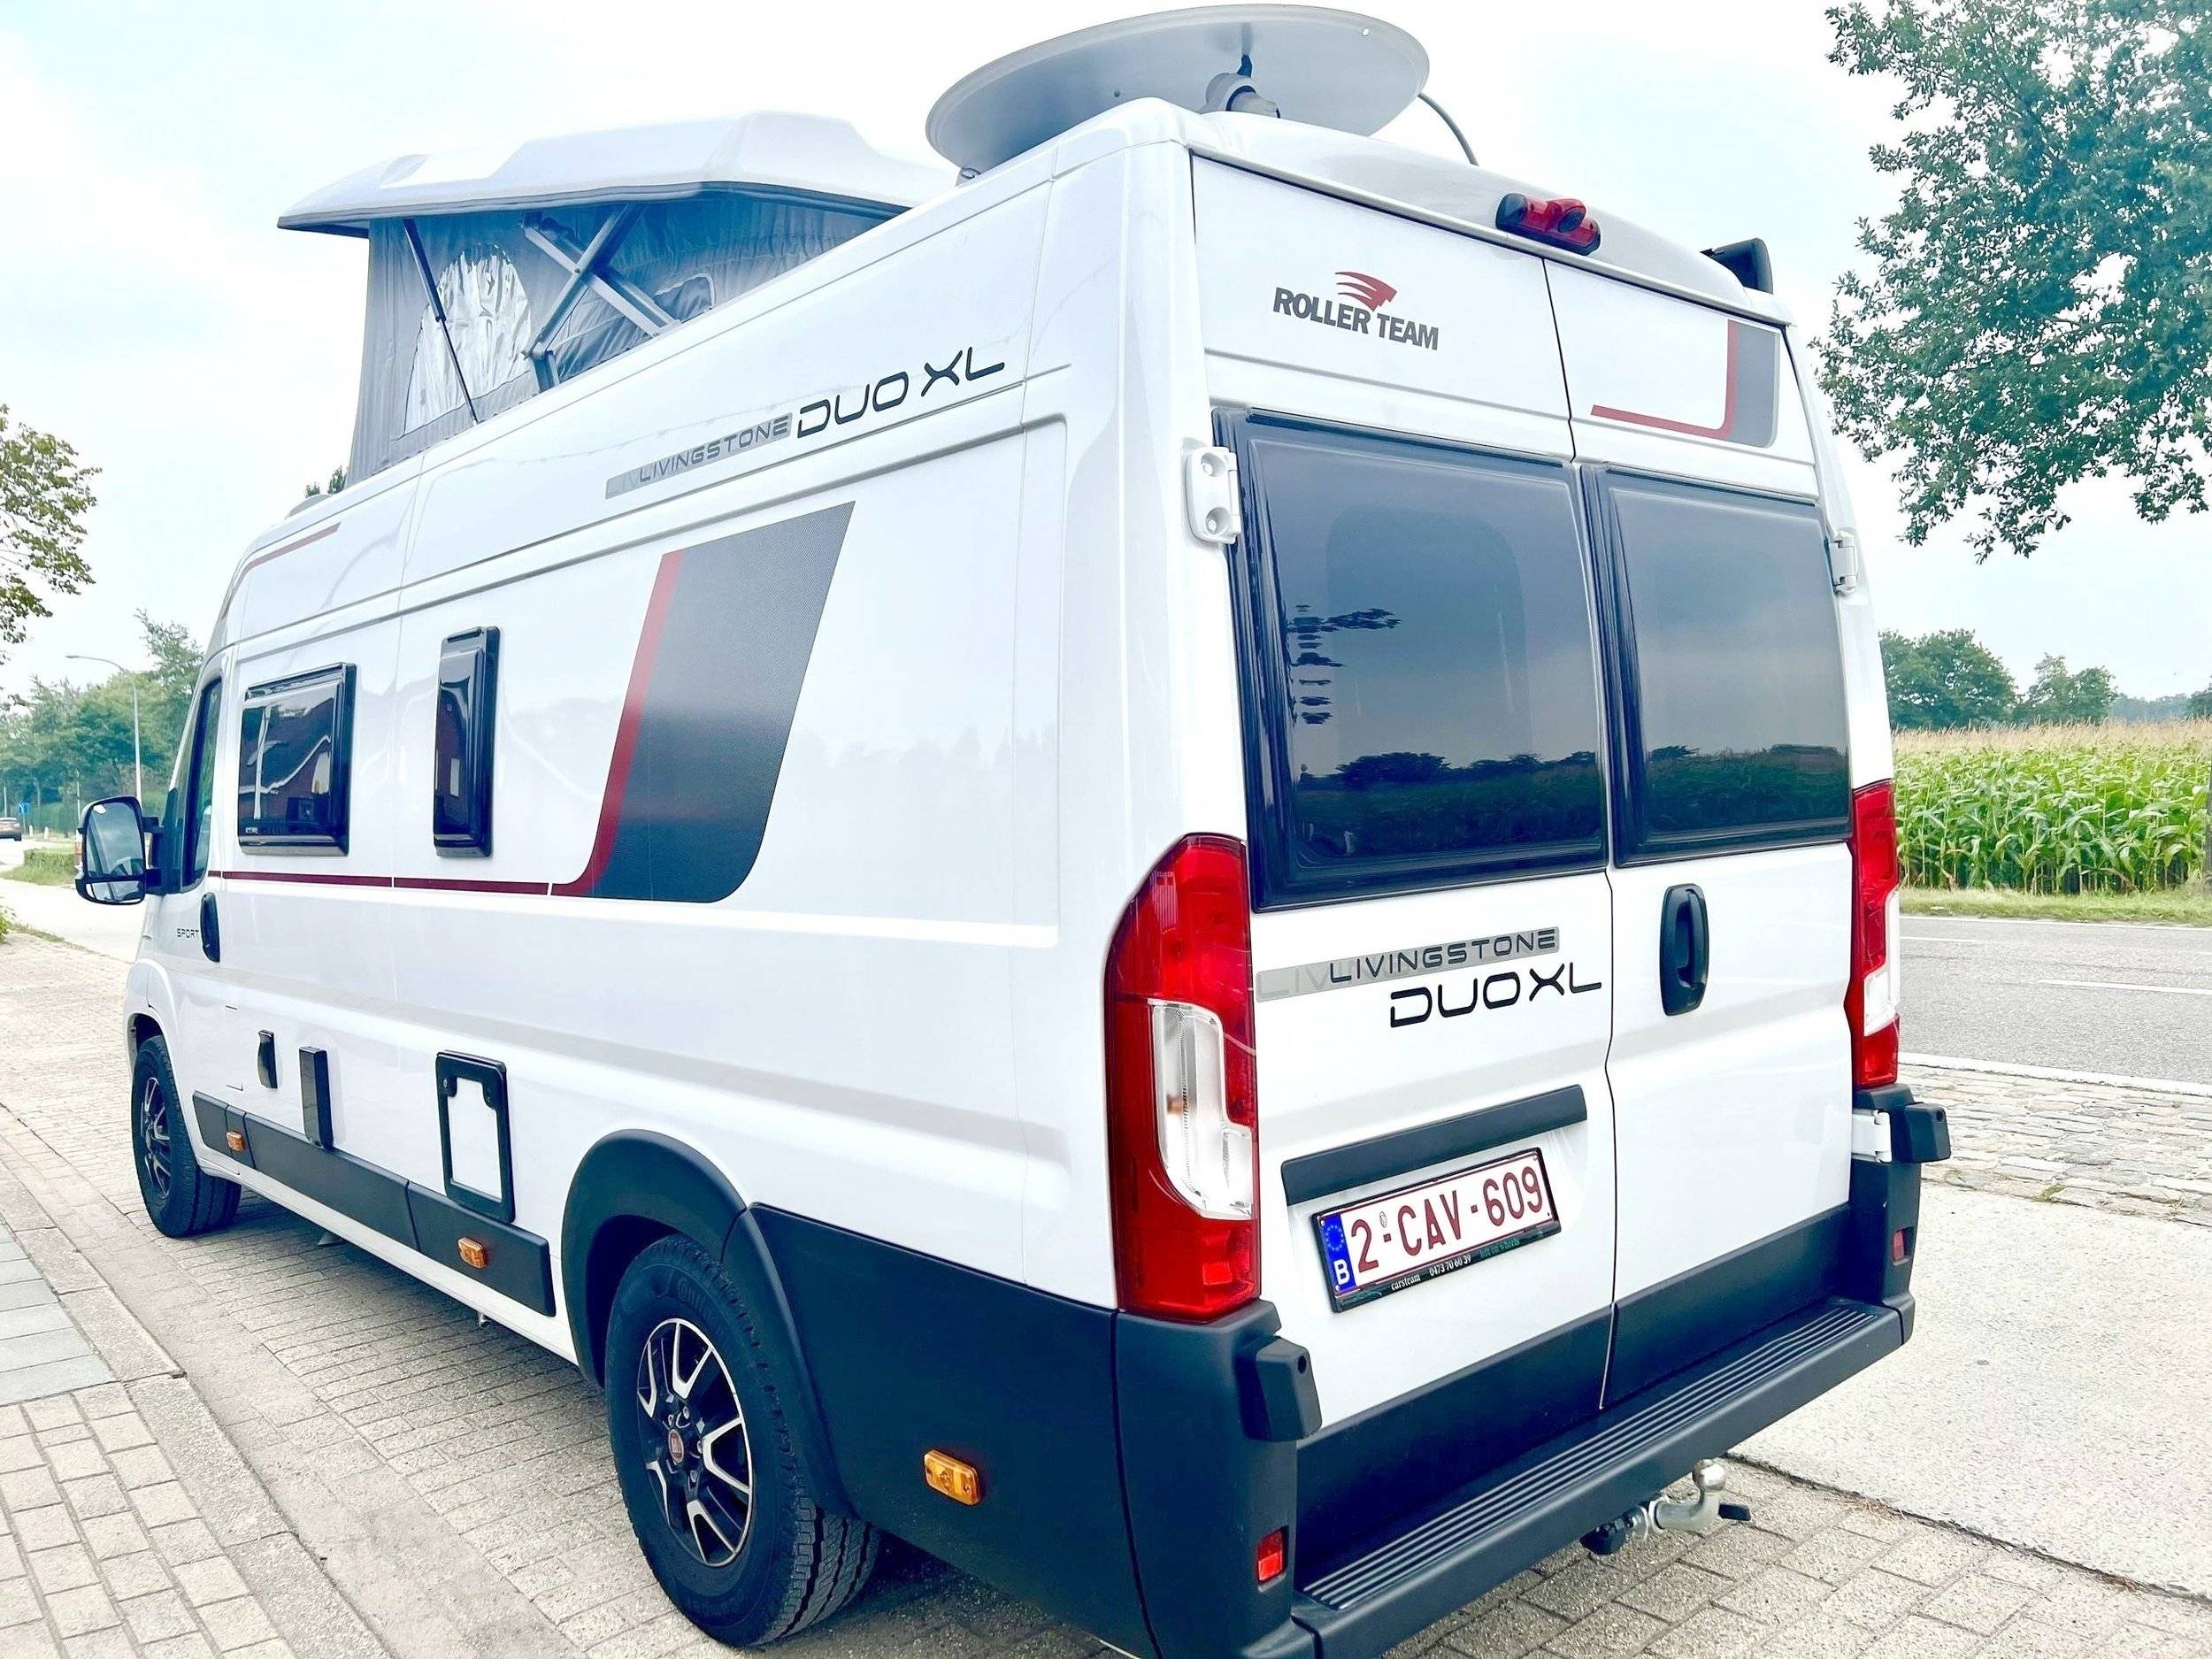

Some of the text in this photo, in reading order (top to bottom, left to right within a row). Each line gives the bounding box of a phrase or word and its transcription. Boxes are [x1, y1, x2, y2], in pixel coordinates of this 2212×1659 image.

[1272, 286, 1439, 350] ROLLER TEAM
[639, 346, 1005, 483] LIVINGSTONE DUO XL
[177, 927, 199, 938] SPORT
[1330, 928, 1556, 983] LIVINGSTONE
[1350, 1165, 1543, 1273] 2-CAV-609
[1333, 1258, 1350, 1286] B
